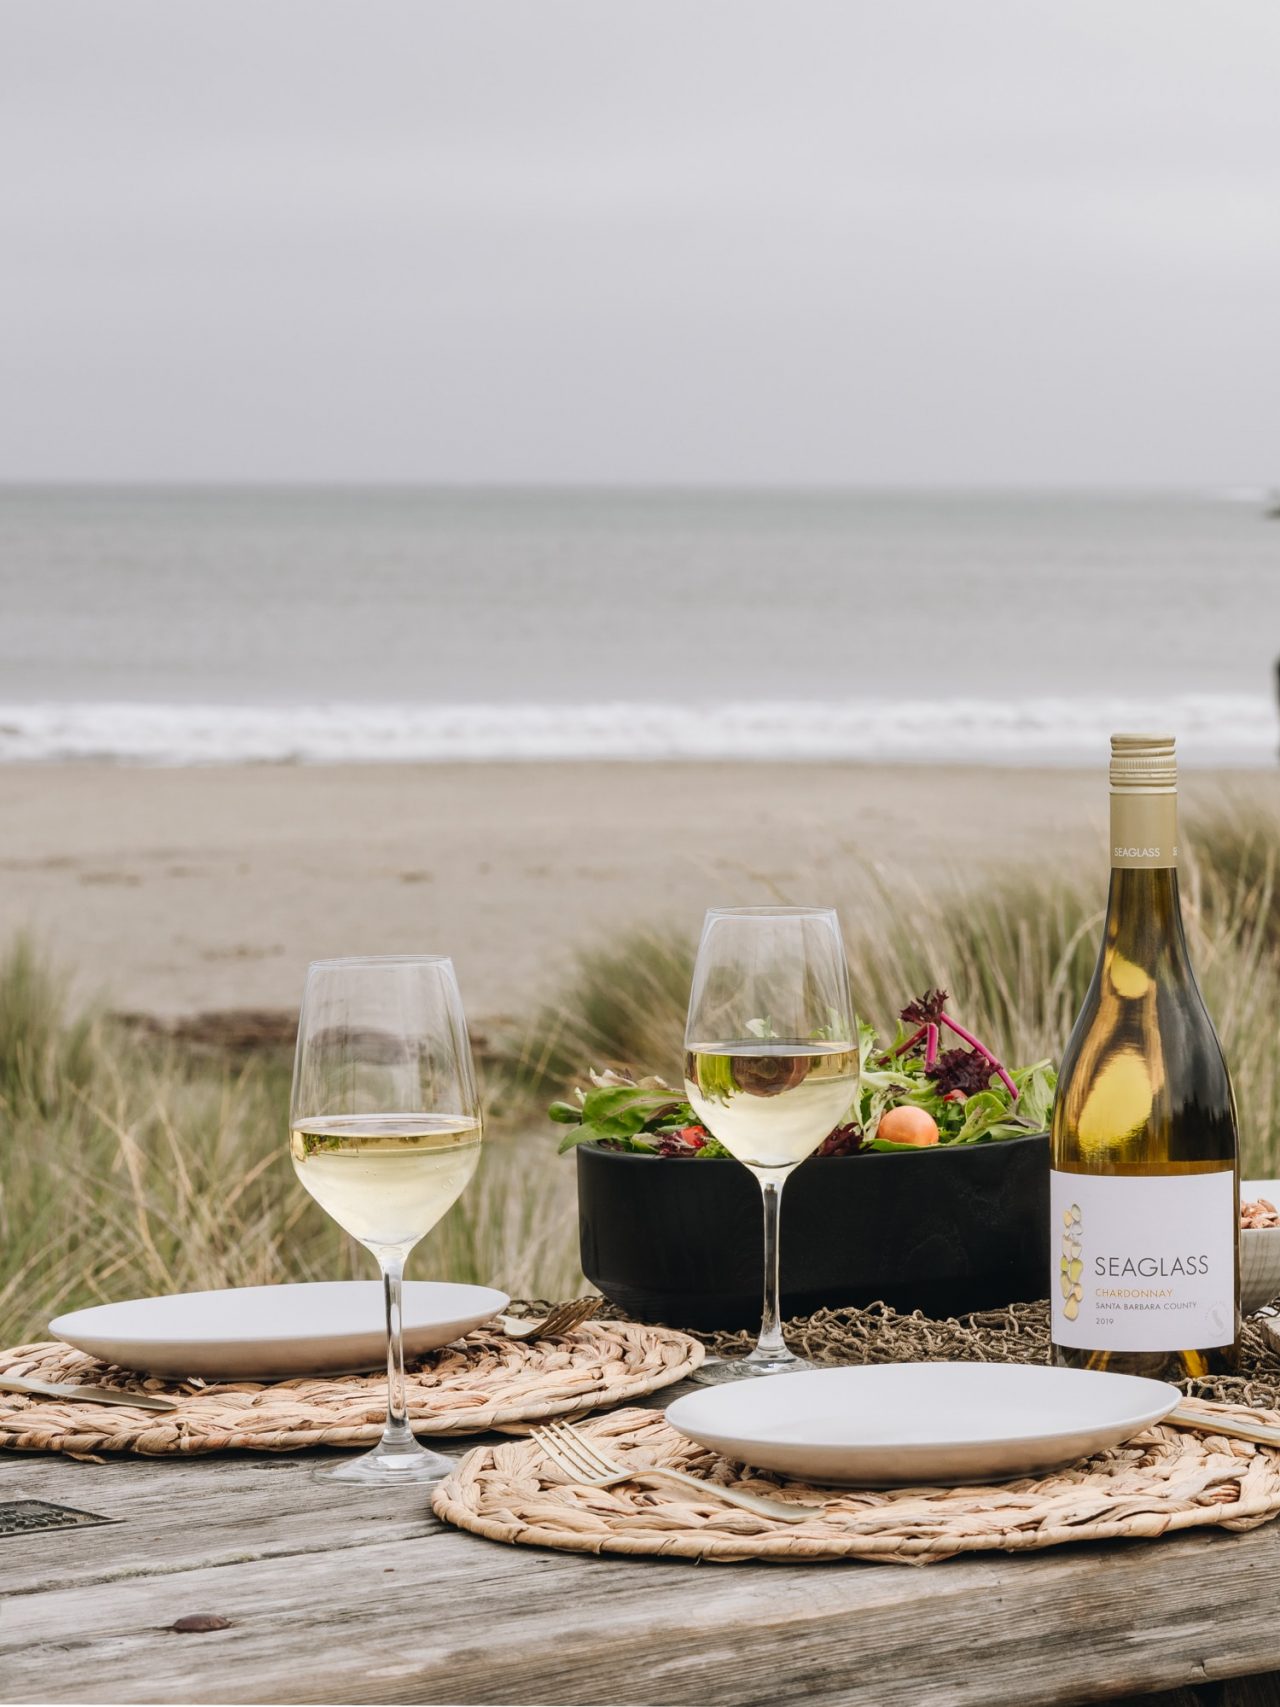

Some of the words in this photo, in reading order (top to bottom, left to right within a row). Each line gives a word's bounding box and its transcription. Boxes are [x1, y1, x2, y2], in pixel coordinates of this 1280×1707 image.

[1114, 847, 1160, 857] SEAGLASS
[1095, 1255, 1209, 1277] SEAGLASS
[1095, 1288, 1174, 1299] CHARDONNAY
[1095, 1302, 1121, 1310] SANTA
[1123, 1303, 1161, 1311] BARBARA
[1163, 1301, 1197, 1310] COUNTY
[1096, 1317, 1115, 1326] 2019
